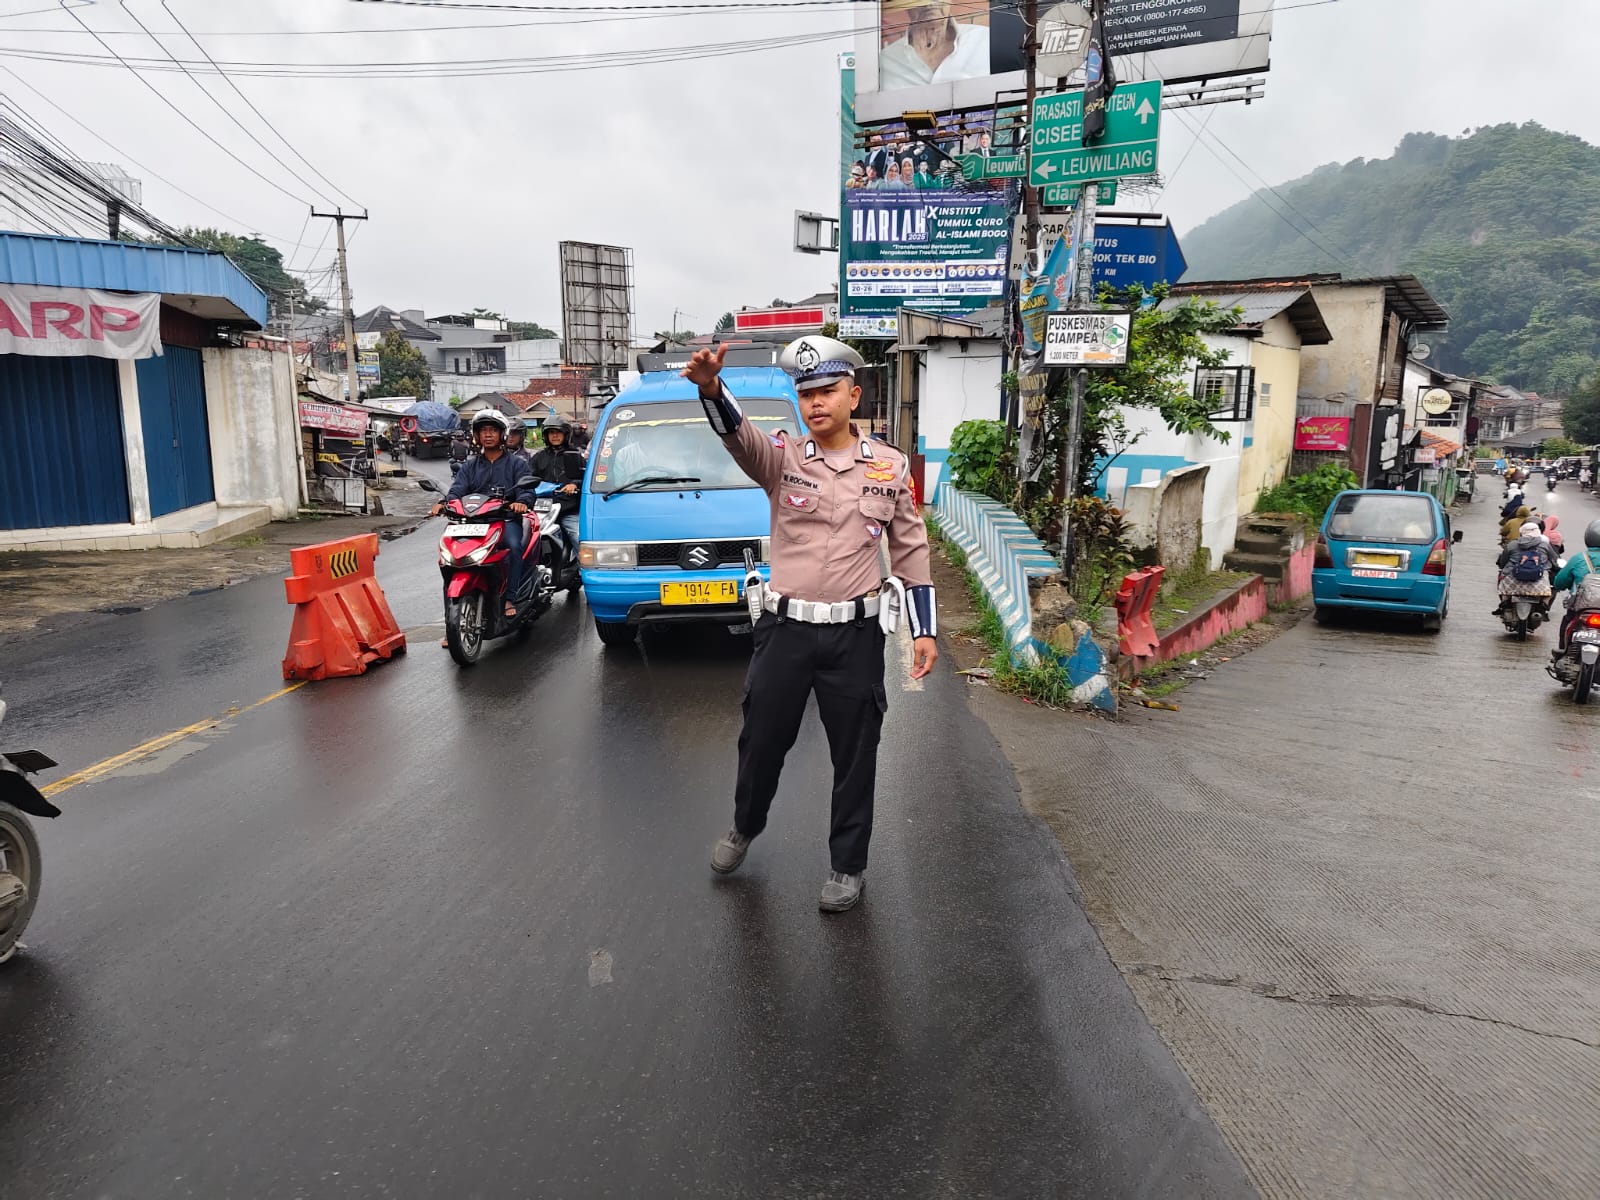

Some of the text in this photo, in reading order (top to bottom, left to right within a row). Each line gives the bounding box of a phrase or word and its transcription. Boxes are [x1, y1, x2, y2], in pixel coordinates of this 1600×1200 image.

[1103, 5, 1128, 16] NKER
[1124, 29, 1157, 40] MEMBERI
[1158, 24, 1187, 35] KEPADA
[1134, 34, 1179, 46] PEREMPUAN
[1180, 30, 1204, 40] HAMIL
[1035, 100, 1081, 122] PRASASTI
[1105, 93, 1137, 113] UTEUN
[1061, 151, 1153, 176] LEUWILIANG
[1047, 186, 1111, 202] ciamea
[852, 208, 926, 242] HARLAH
[938, 206, 983, 215] INSTITUT
[937, 218, 1004, 227] UMMUL QURO
[908, 233, 926, 241] 2025
[935, 229, 1007, 239] AL-ISLAMI BOGO
[1115, 254, 1137, 264] TEK
[1137, 255, 1156, 264] BIO
[1104, 268, 1117, 276] KM
[1048, 317, 1106, 330] PUSKESMAS
[1047, 332, 1099, 344] CIAMPEA
[1063, 351, 1079, 360] METER
[863, 486, 897, 499] POLRI
[662, 582, 735, 598] F 1914 FA
